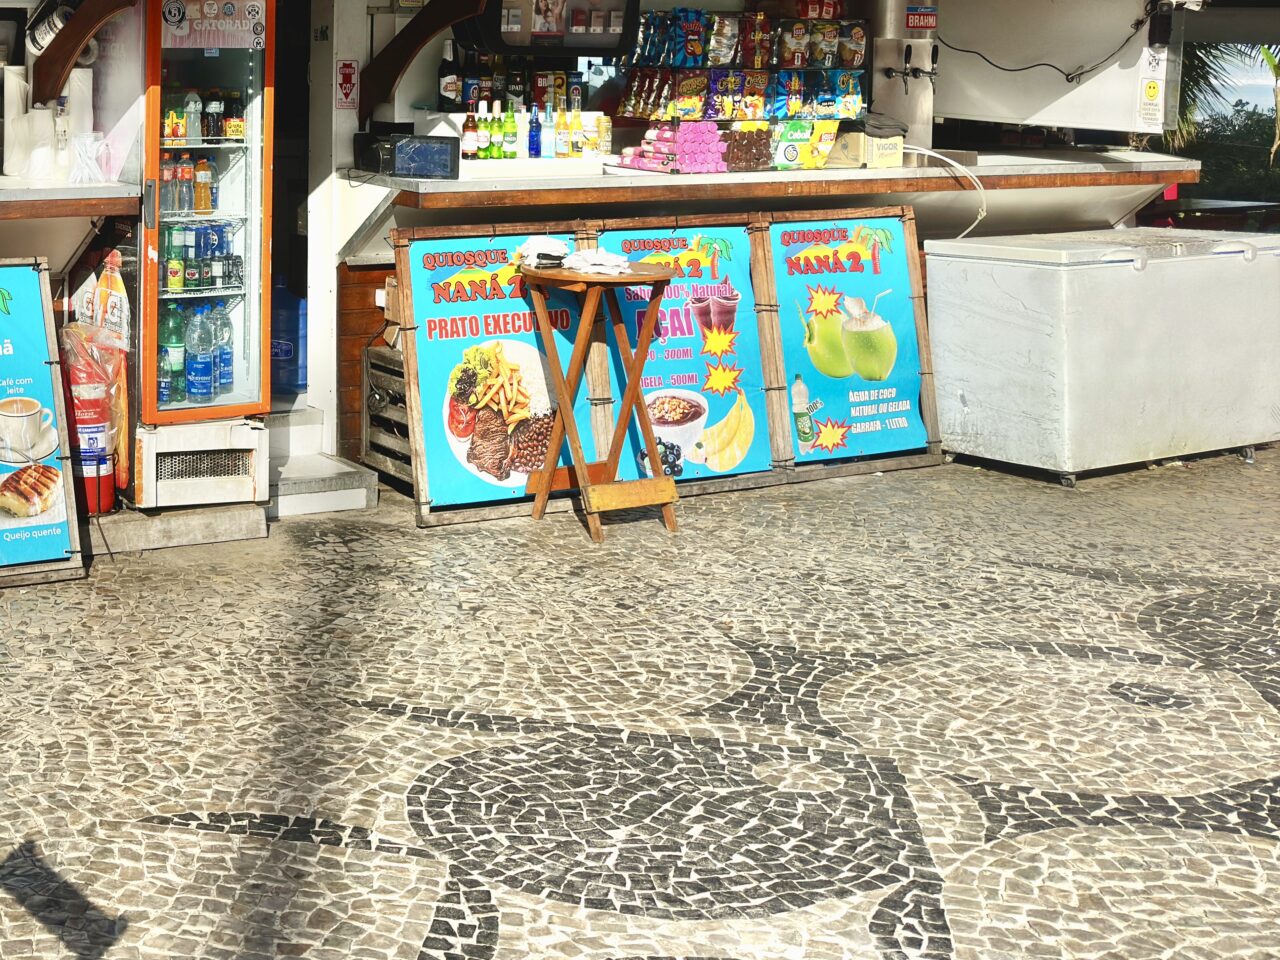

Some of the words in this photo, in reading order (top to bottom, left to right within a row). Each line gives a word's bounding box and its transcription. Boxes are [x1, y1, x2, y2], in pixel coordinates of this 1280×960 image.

[193, 19, 255, 31] GATORAD
[877, 143, 898, 151] VIGOR
[621, 237, 688, 254] QUIOSQUE
[780, 228, 849, 247] QUIOSQUE
[423, 249, 508, 270] QUIOSQUE
[785, 250, 846, 275] NANÁ
[846, 251, 864, 274] 2
[686, 258, 703, 279] 2
[431, 273, 506, 303] NANÁ
[691, 282, 733, 298] Natural
[427, 315, 480, 340] PRATO
[483, 308, 570, 337] EXECUTVO
[664, 348, 693, 360] 300ML
[15, 376, 33, 385] com
[639, 376, 663, 388] IGELA
[671, 373, 699, 386] 500ML
[6, 385, 25, 395] leite
[848, 388, 869, 403] ÁGUA
[870, 388, 879, 401] DE
[879, 387, 897, 400] COCO
[805, 398, 824, 415] 100%
[850, 402, 878, 417] NATURAL
[879, 402, 888, 414] OU
[888, 399, 911, 413] GELADA
[851, 419, 881, 434] GARRAFA
[891, 416, 908, 430] LITRO
[3, 529, 30, 542] Queijo
[30, 526, 62, 540] quente
